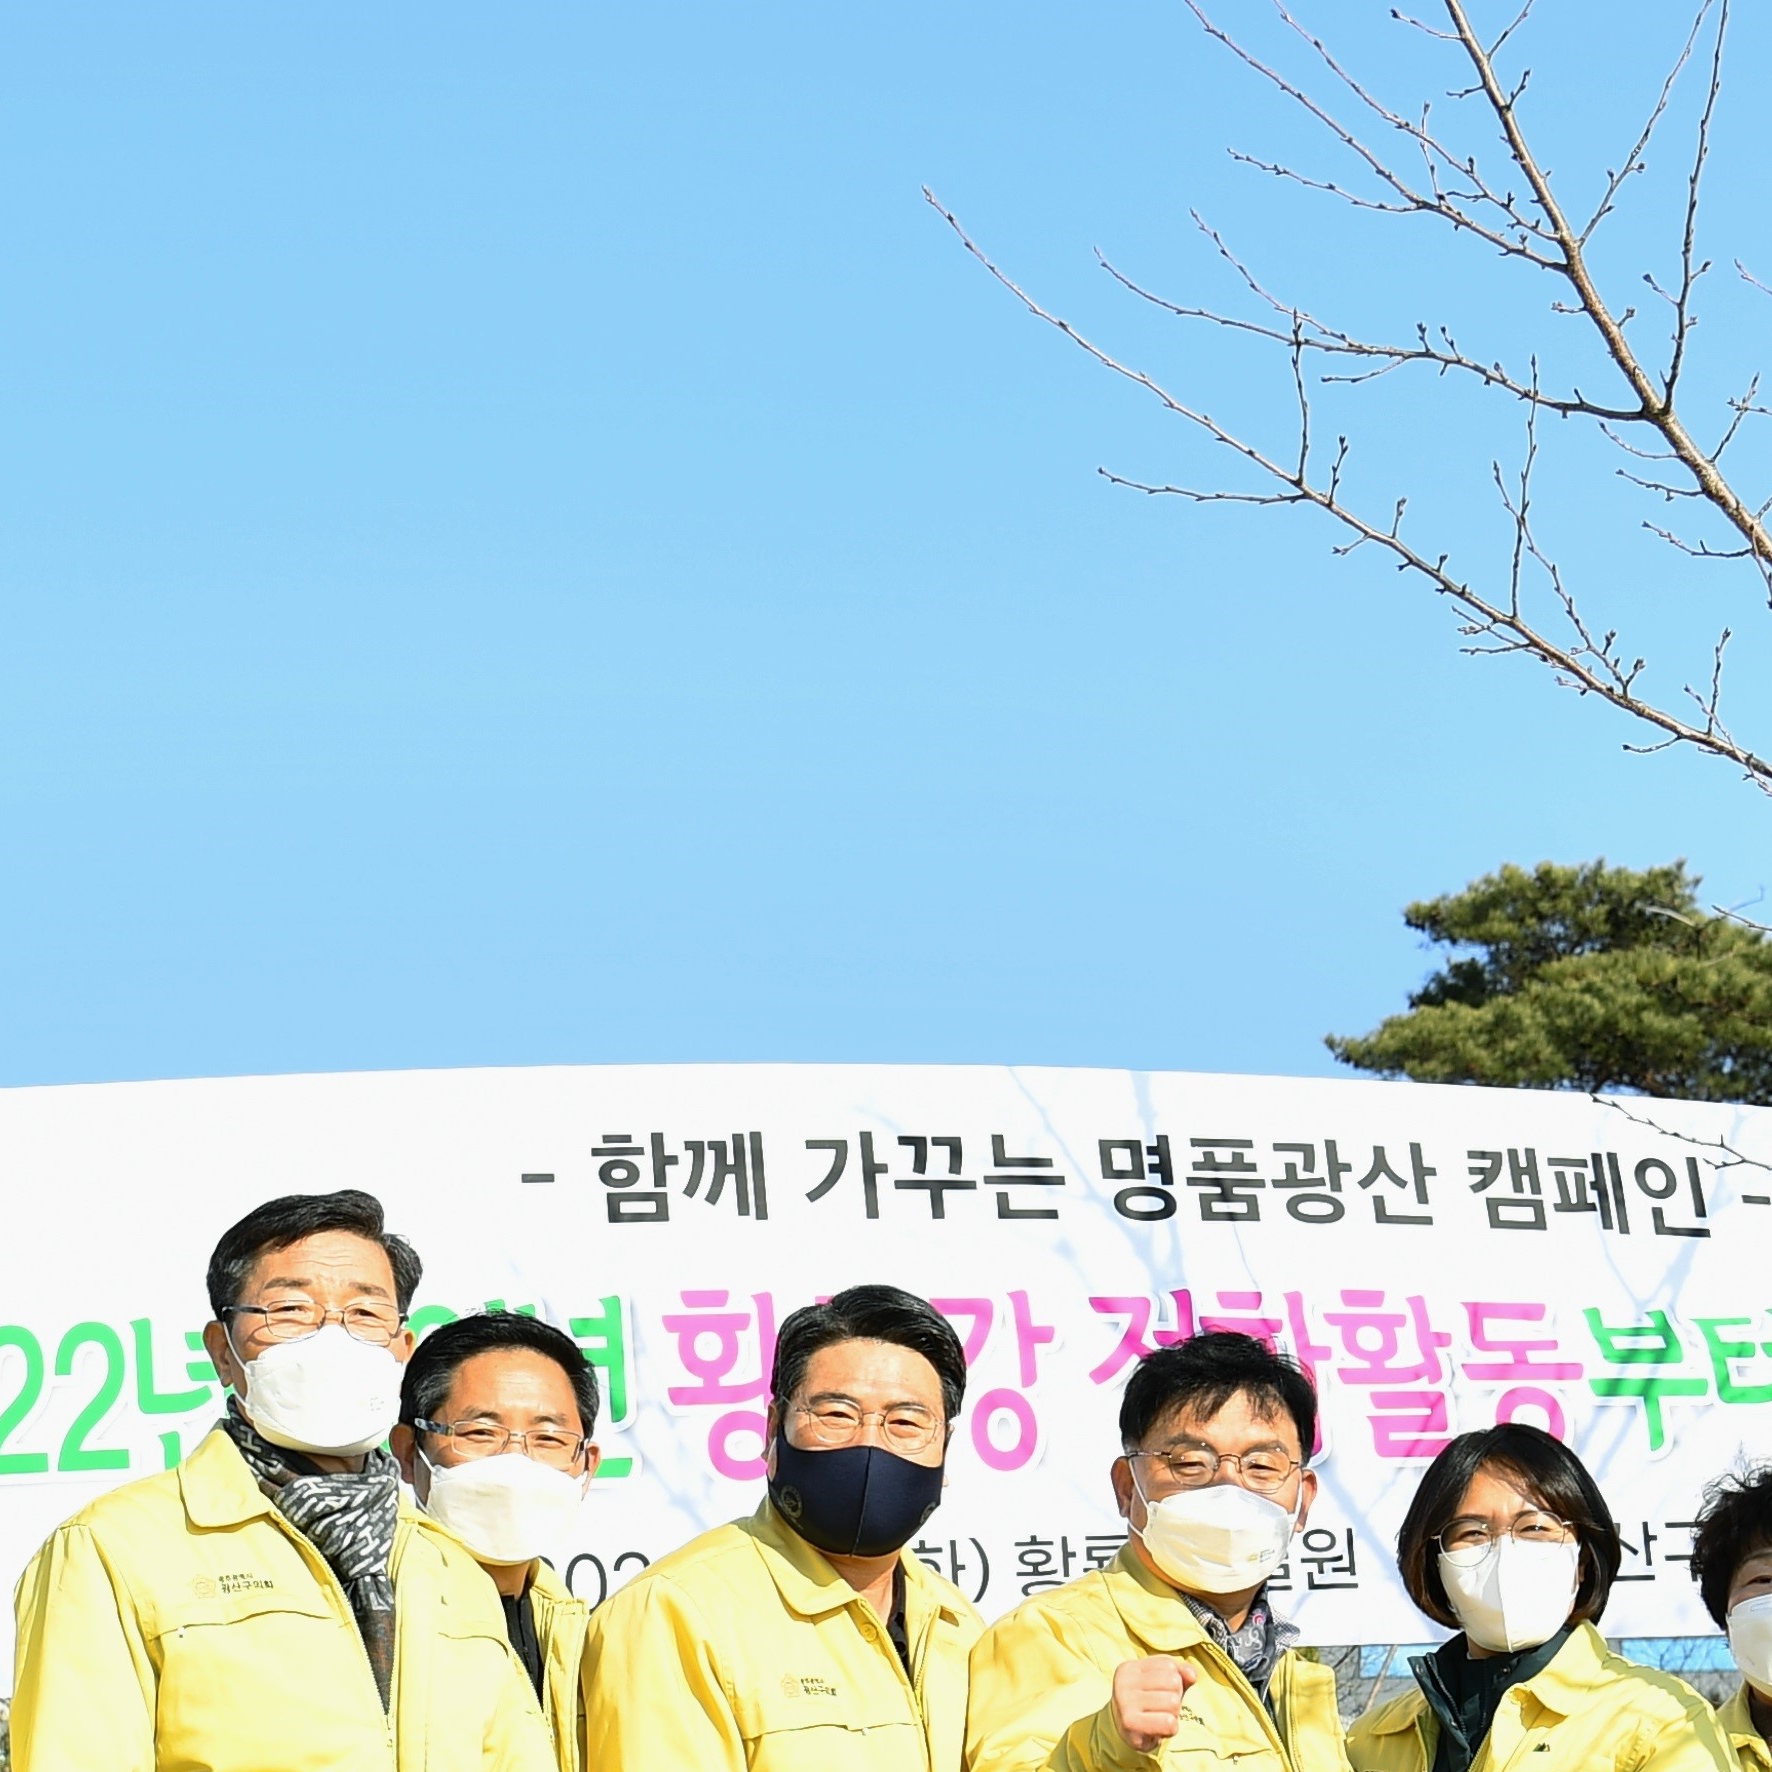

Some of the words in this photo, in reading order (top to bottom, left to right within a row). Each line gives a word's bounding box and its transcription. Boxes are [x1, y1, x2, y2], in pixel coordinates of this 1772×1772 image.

[590, 1130, 769, 1224] 함께
[804, 1130, 1066, 1221] 가꾸는
[1097, 1133, 1437, 1226] 명품광산
[1466, 1146, 1712, 1239] 캠페인
[661, 1288, 1056, 1482] 황강
